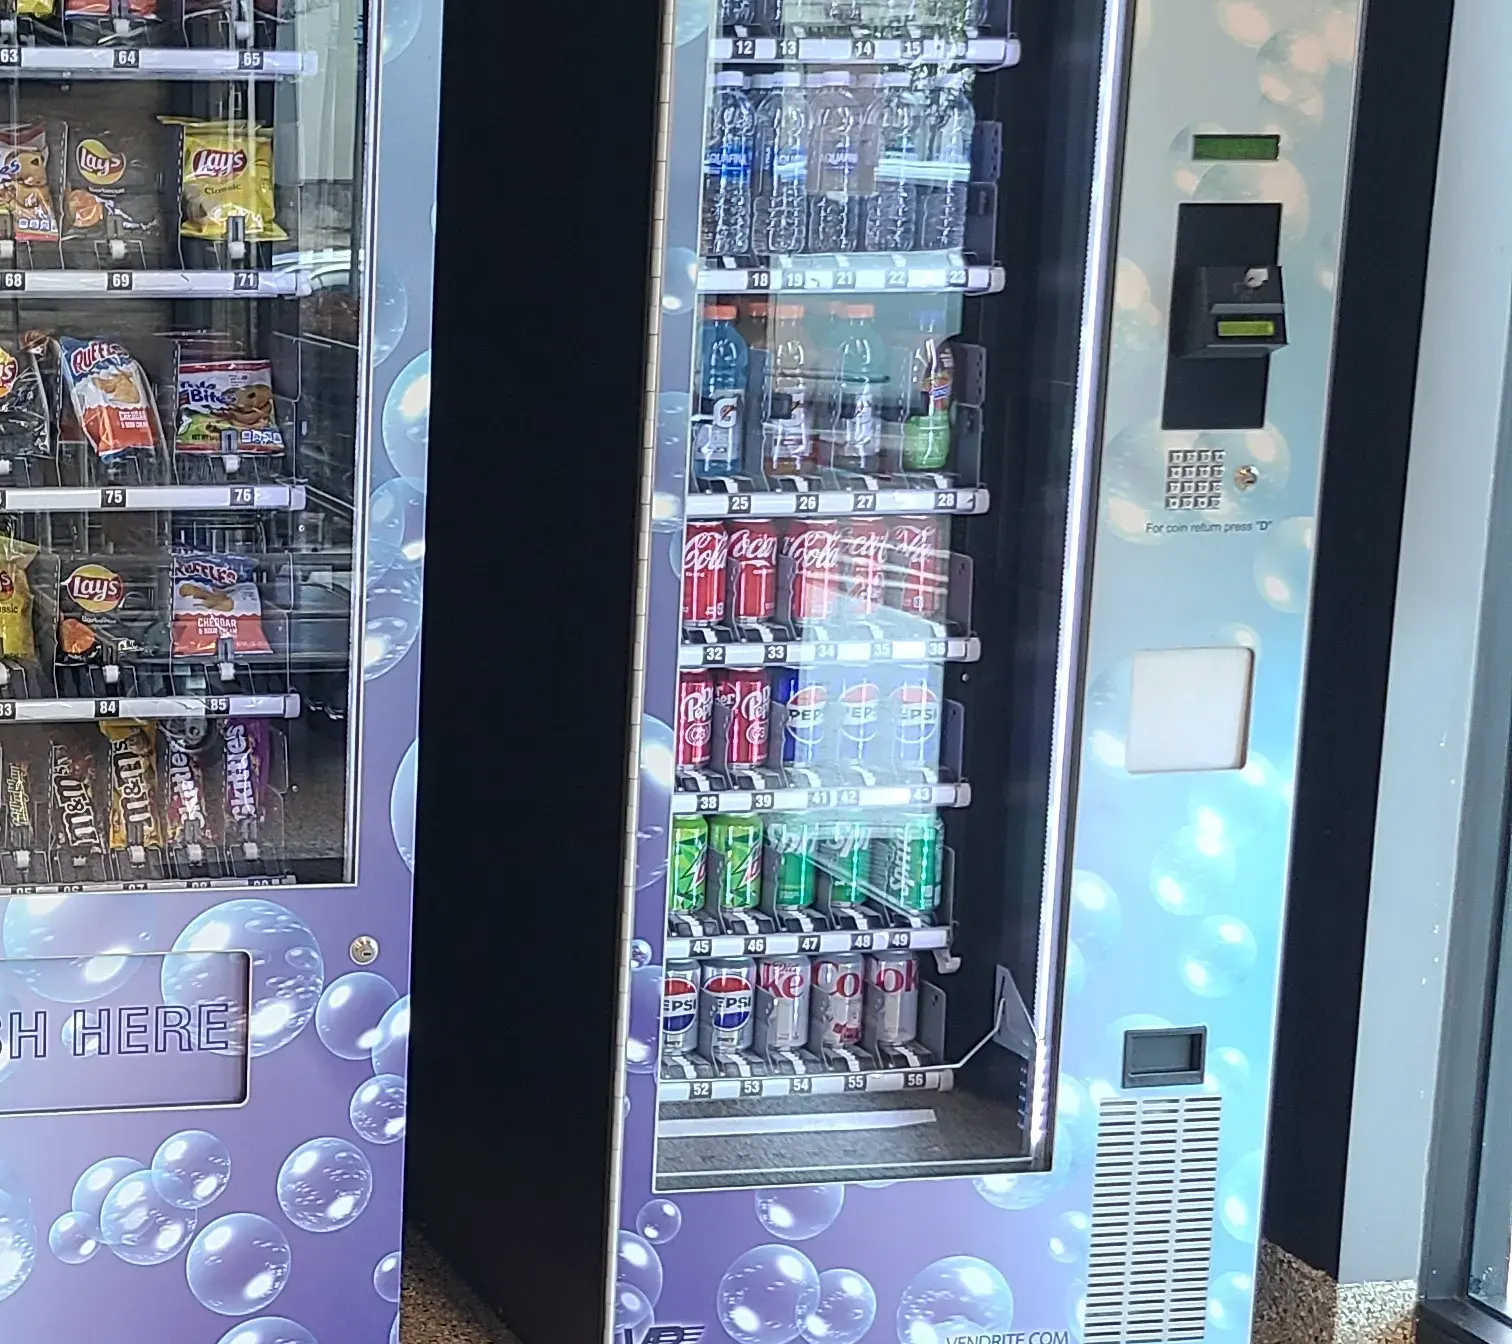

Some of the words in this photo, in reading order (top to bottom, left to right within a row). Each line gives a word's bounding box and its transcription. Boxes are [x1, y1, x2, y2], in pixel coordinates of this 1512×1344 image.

[735, 41, 754, 55] 12
[780, 40, 797, 55] 13
[855, 41, 872, 55] 14
[904, 40, 922, 55] 15
[0, 49, 18, 62] 63
[118, 51, 136, 64] 64
[243, 52, 260, 66] 65
[194, 148, 247, 176] Lay's
[5, 272, 22, 287] 68
[112, 272, 130, 287] 69
[238, 272, 255, 287] 71
[752, 273, 769, 287] 18
[786, 273, 804, 287] 19
[837, 271, 854, 285] 21
[888, 271, 905, 285] 22
[949, 270, 967, 284] 23
[105, 490, 123, 504] 75
[234, 487, 251, 501] 76
[938, 492, 956, 506] 28
[731, 496, 749, 510] 25
[799, 495, 816, 510] 26
[856, 494, 874, 509] 27
[1145, 522, 1164, 534] For
[1166, 522, 1188, 533] coin
[1223, 522, 1253, 534] press
[72, 576, 120, 599] Lay's
[706, 646, 724, 661] 32
[767, 644, 785, 659] 33
[817, 643, 835, 657] 34
[873, 642, 890, 656] 35
[929, 641, 946, 655] 36
[99, 699, 116, 714] 84
[209, 697, 227, 711] 85
[225, 724, 258, 821] Skittles
[755, 794, 773, 808] 39
[913, 788, 930, 802] 43
[700, 795, 718, 810] 38
[692, 940, 710, 954] 45
[747, 939, 764, 953] 46
[801, 937, 819, 951] 47
[854, 935, 871, 948] 48
[891, 933, 908, 947] 49
[73, 1003, 229, 1057] HERE
[743, 1079, 761, 1094] 53
[793, 1078, 810, 1092] 54
[847, 1075, 864, 1090] 55
[907, 1073, 924, 1087] 56
[692, 1082, 710, 1097] 52
